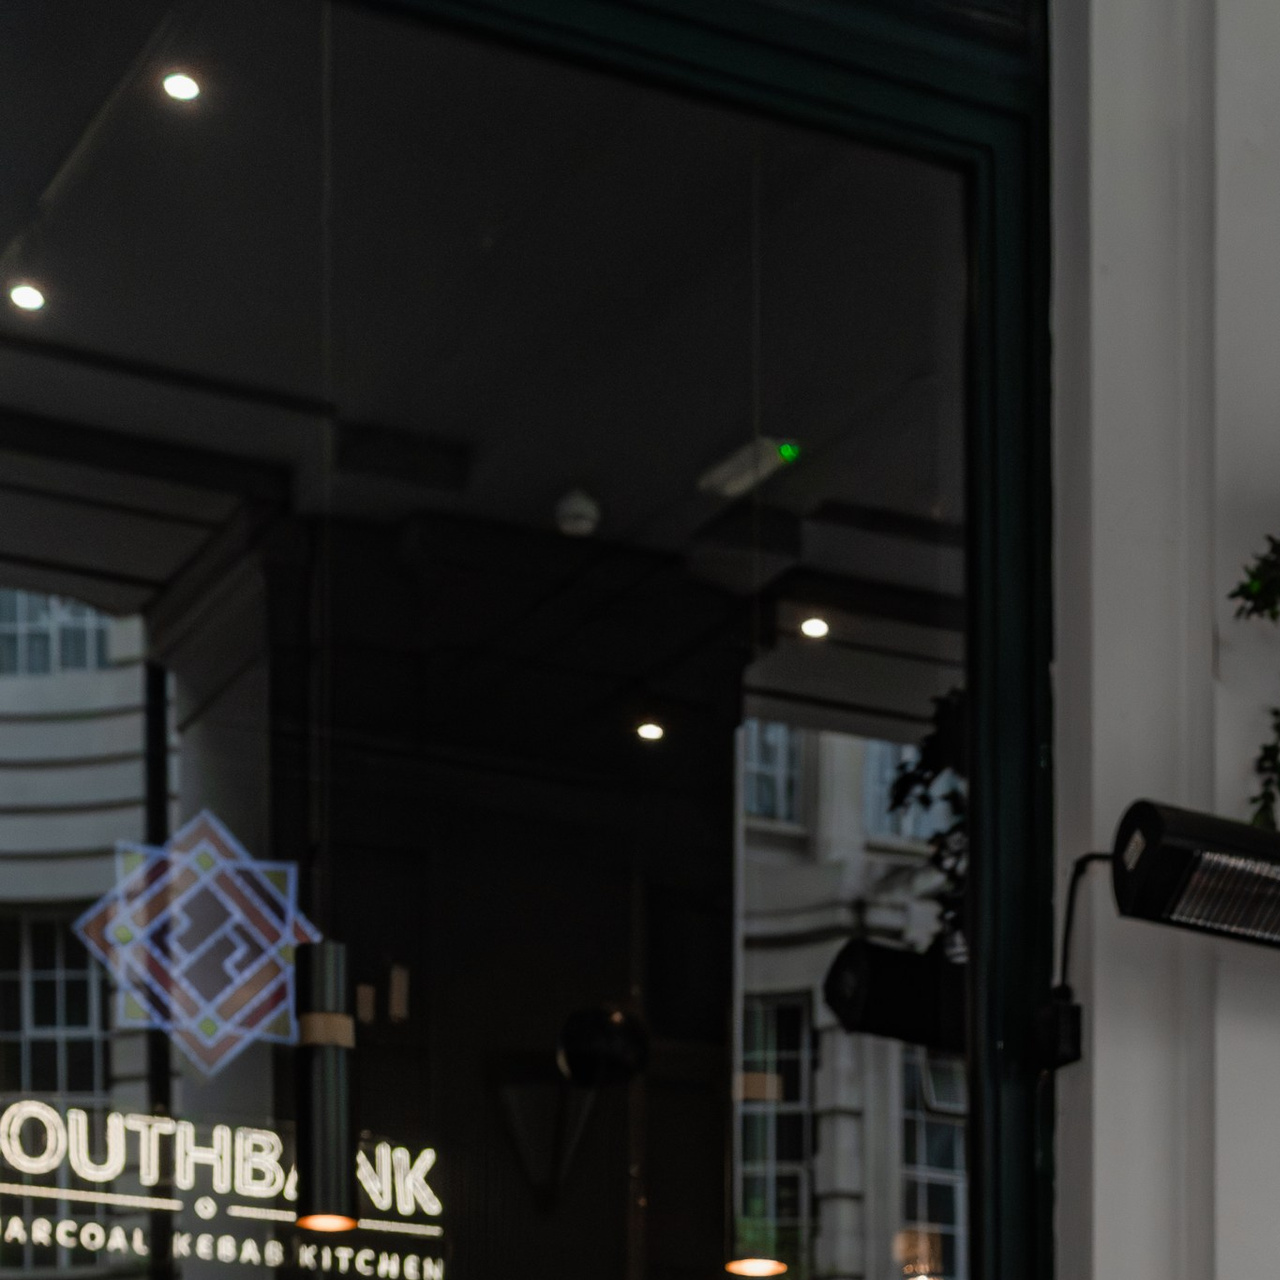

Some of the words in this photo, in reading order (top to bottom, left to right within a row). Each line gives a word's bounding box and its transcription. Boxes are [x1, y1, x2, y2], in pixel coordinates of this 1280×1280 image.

[0, 1100, 443, 1217] OUTHBNK
[0, 1215, 149, 1256] ARCOAL
[173, 1232, 284, 1267] KEBAB
